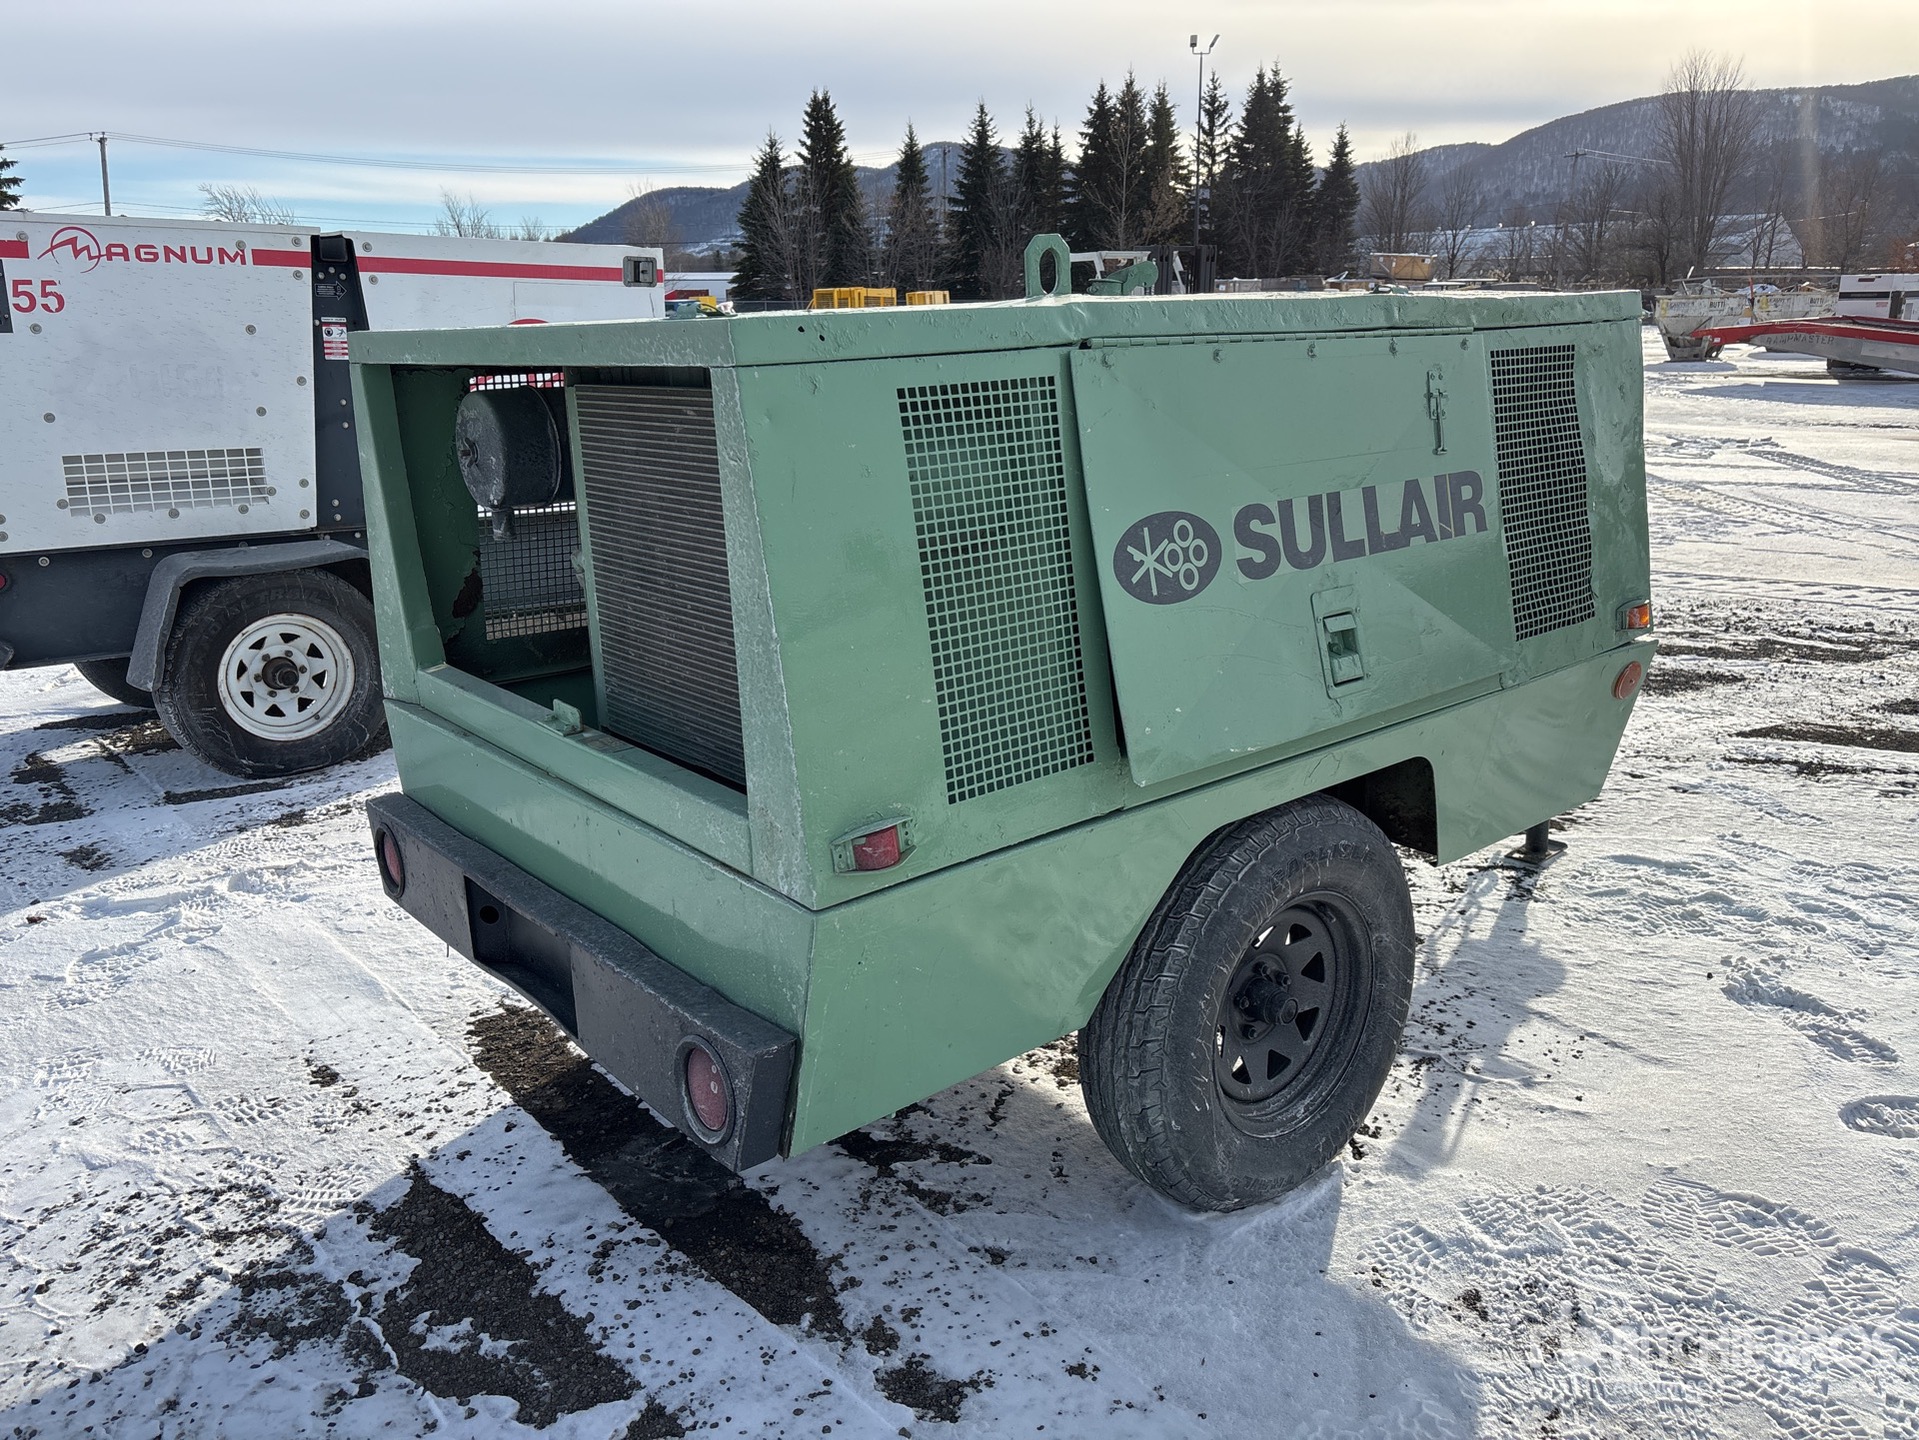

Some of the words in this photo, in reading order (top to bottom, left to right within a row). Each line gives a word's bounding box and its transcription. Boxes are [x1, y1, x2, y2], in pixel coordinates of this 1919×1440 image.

[37, 228, 248, 271] MAGNUM
[12, 279, 66, 314] 55
[1766, 333, 1835, 345] RAMPMASTER
[1233, 470, 1488, 580] SULLAIR
[1270, 842, 1376, 889] CARLISLE
